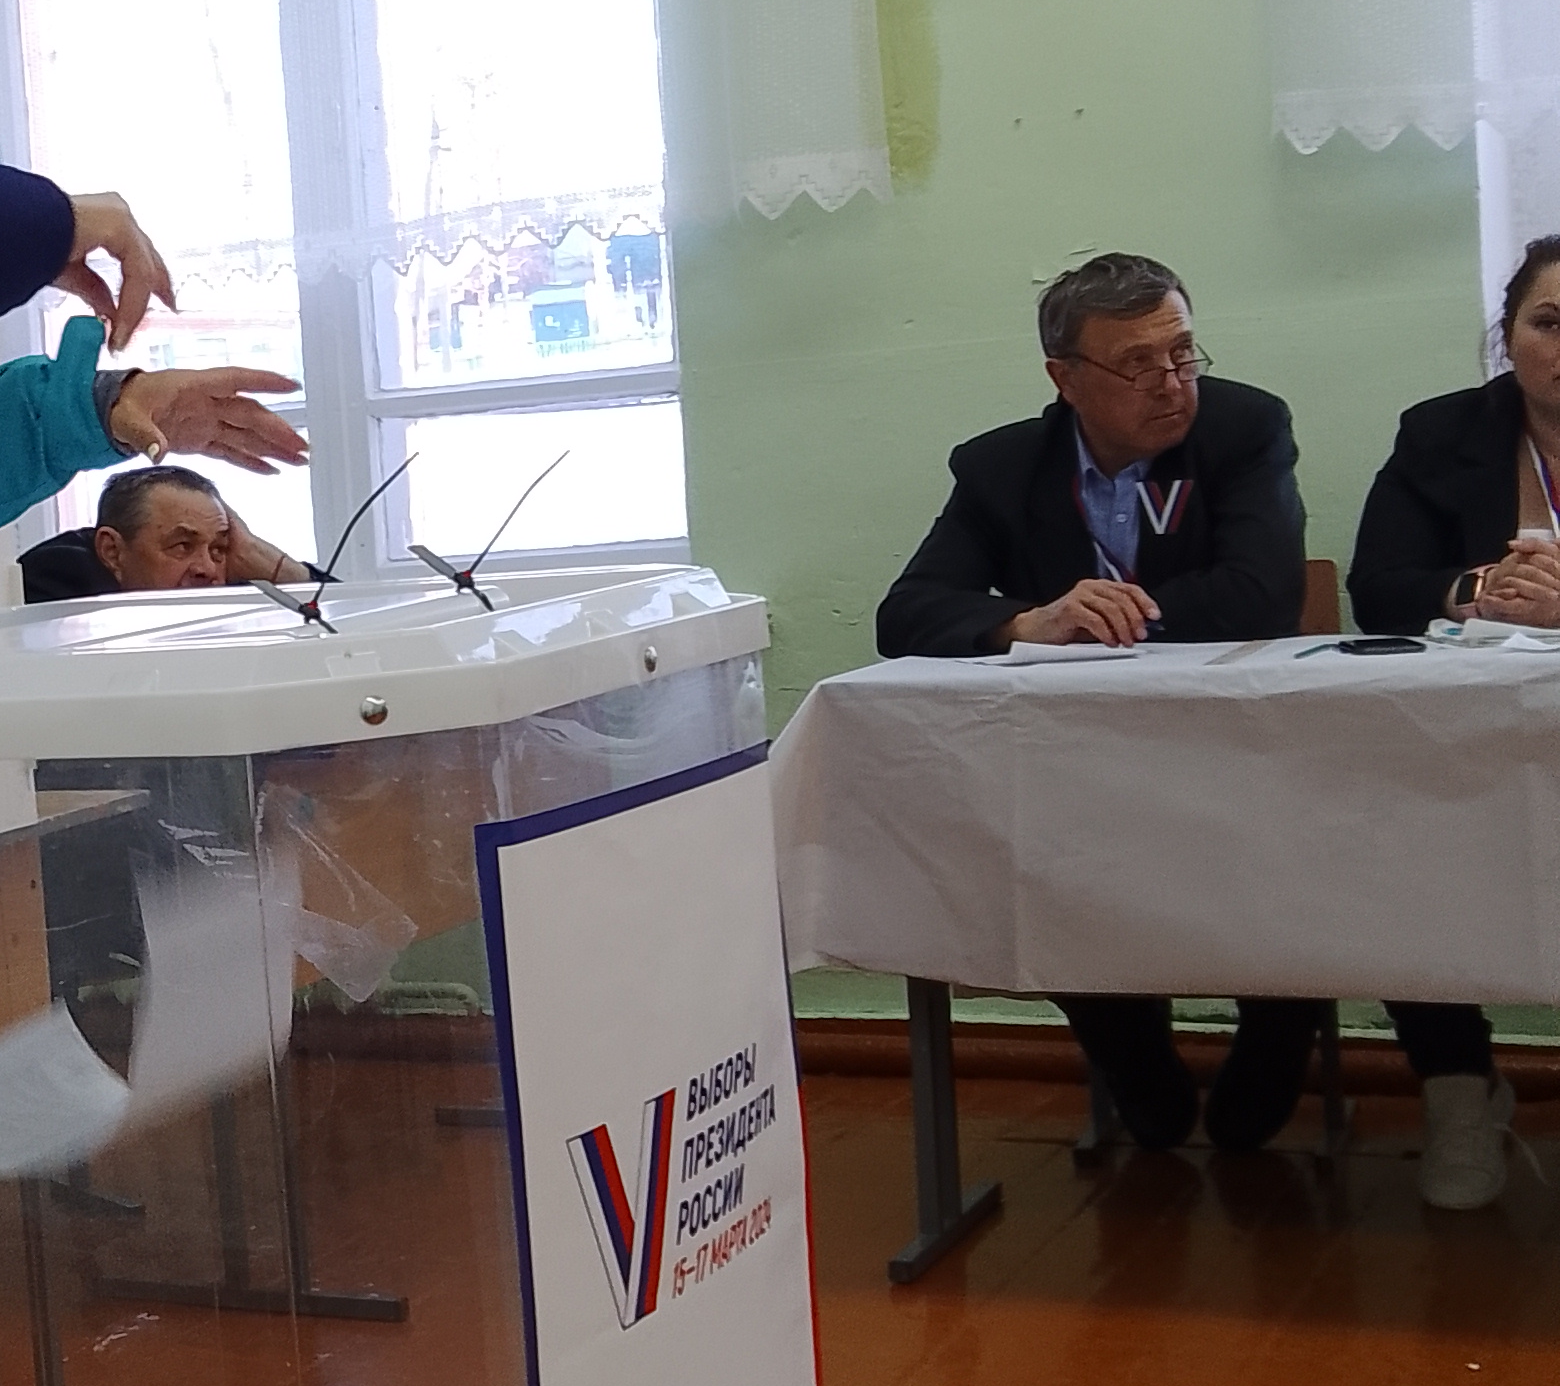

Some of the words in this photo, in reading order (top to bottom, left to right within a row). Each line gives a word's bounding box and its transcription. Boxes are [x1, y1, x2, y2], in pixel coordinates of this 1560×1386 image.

[686, 1042, 757, 1122] ВЫБОРЫ
[681, 1083, 776, 1184] ПРЕЗИДЕНТА
[676, 1163, 745, 1246] РОССИИ
